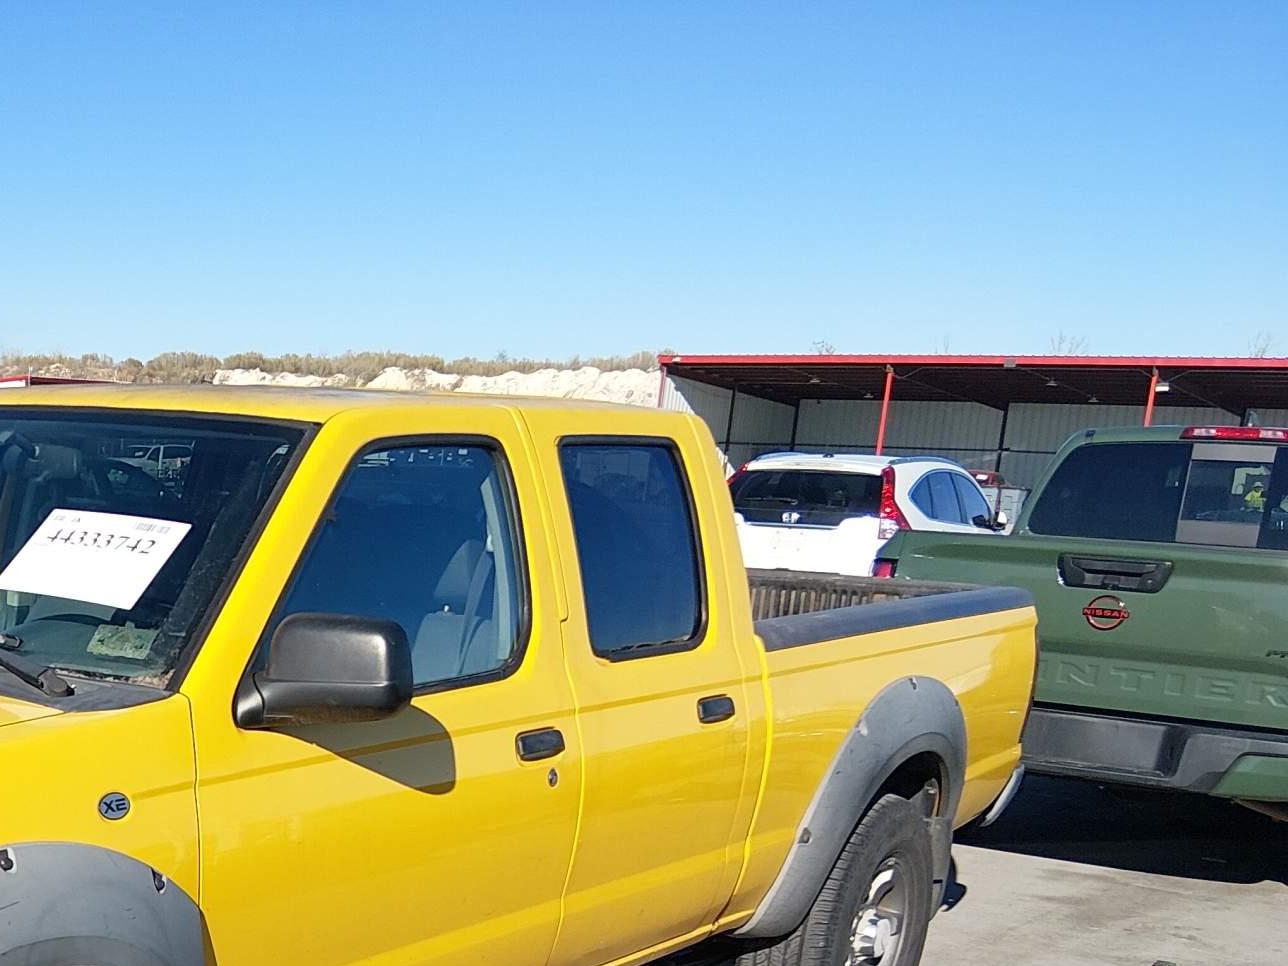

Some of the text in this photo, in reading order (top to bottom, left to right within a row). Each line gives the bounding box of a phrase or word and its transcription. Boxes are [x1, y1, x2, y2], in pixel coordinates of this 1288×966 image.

[47, 529, 156, 554] 44333742
[1083, 608, 1129, 618] NISSAN
[103, 798, 128, 814] XE
